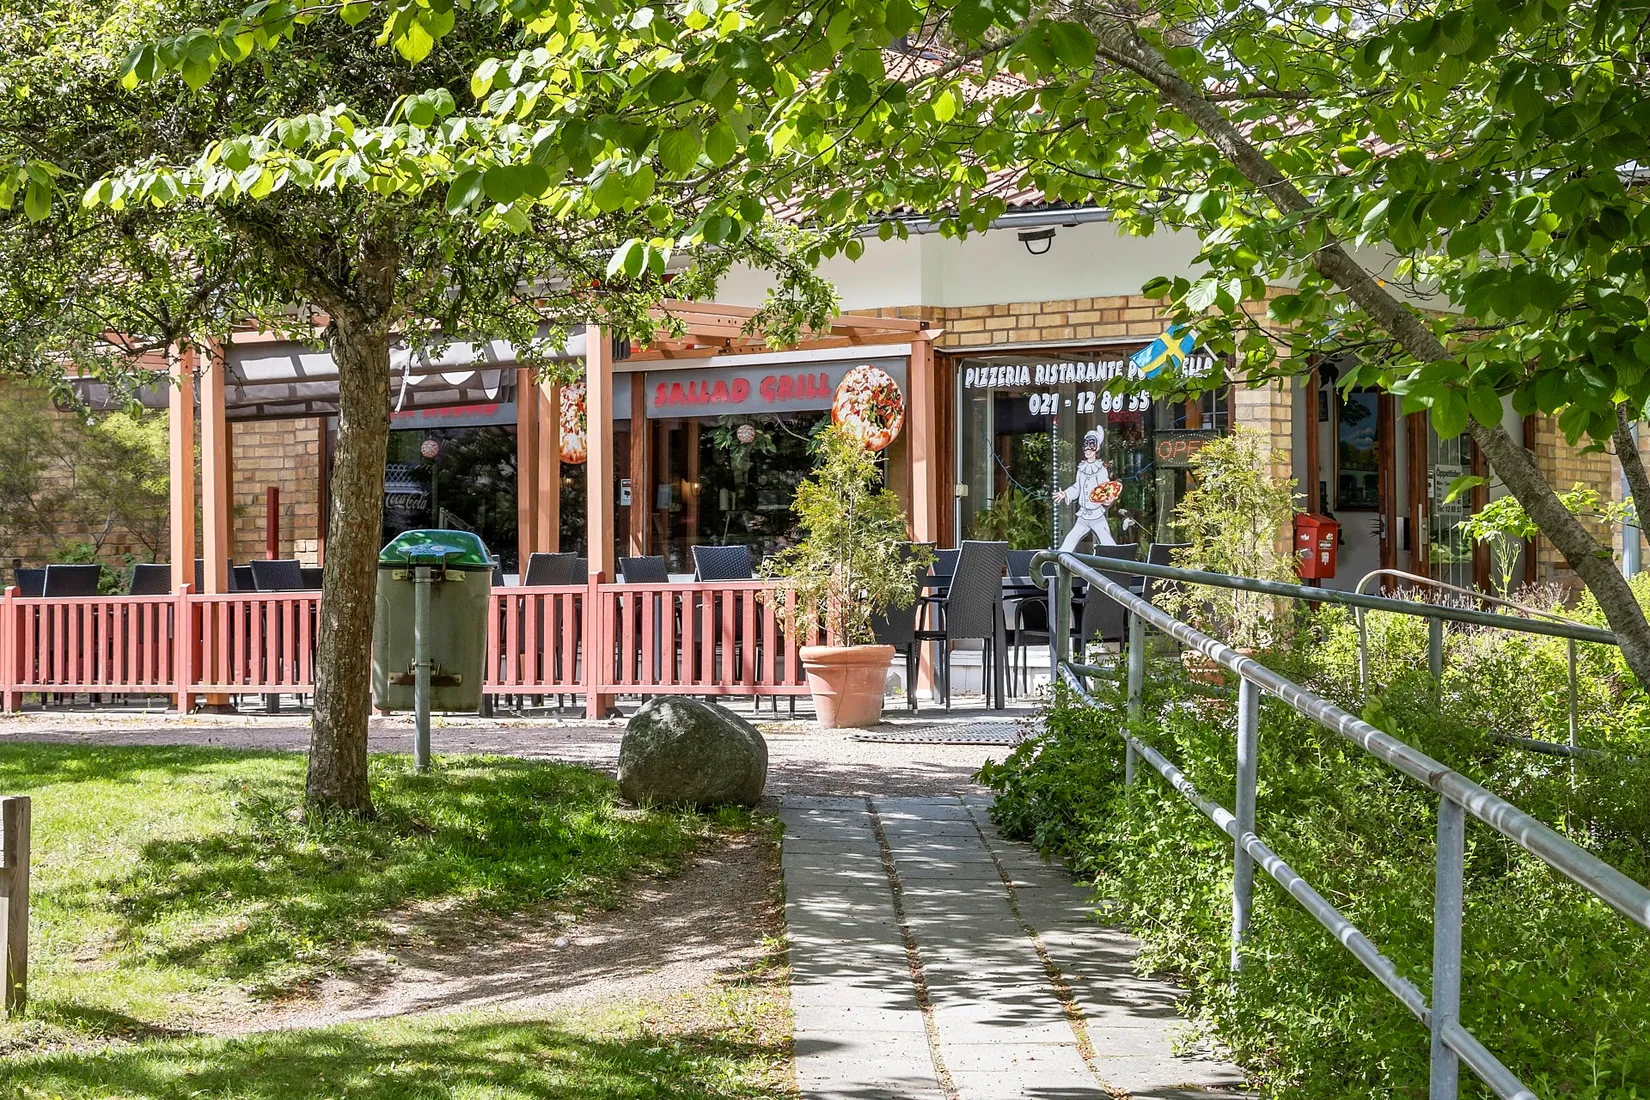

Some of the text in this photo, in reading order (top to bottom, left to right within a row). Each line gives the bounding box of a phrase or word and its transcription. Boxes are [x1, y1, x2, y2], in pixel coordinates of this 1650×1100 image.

[964, 366, 1031, 388] PIZZERIA
[1035, 361, 1124, 385] RISTARANTE
[654, 372, 832, 407] SALLAD GRILL
[1029, 393, 1059, 415] 021
[1077, 391, 1097, 413] 12
[1101, 391, 1124, 412] 88
[1157, 440, 1207, 458] OPE
